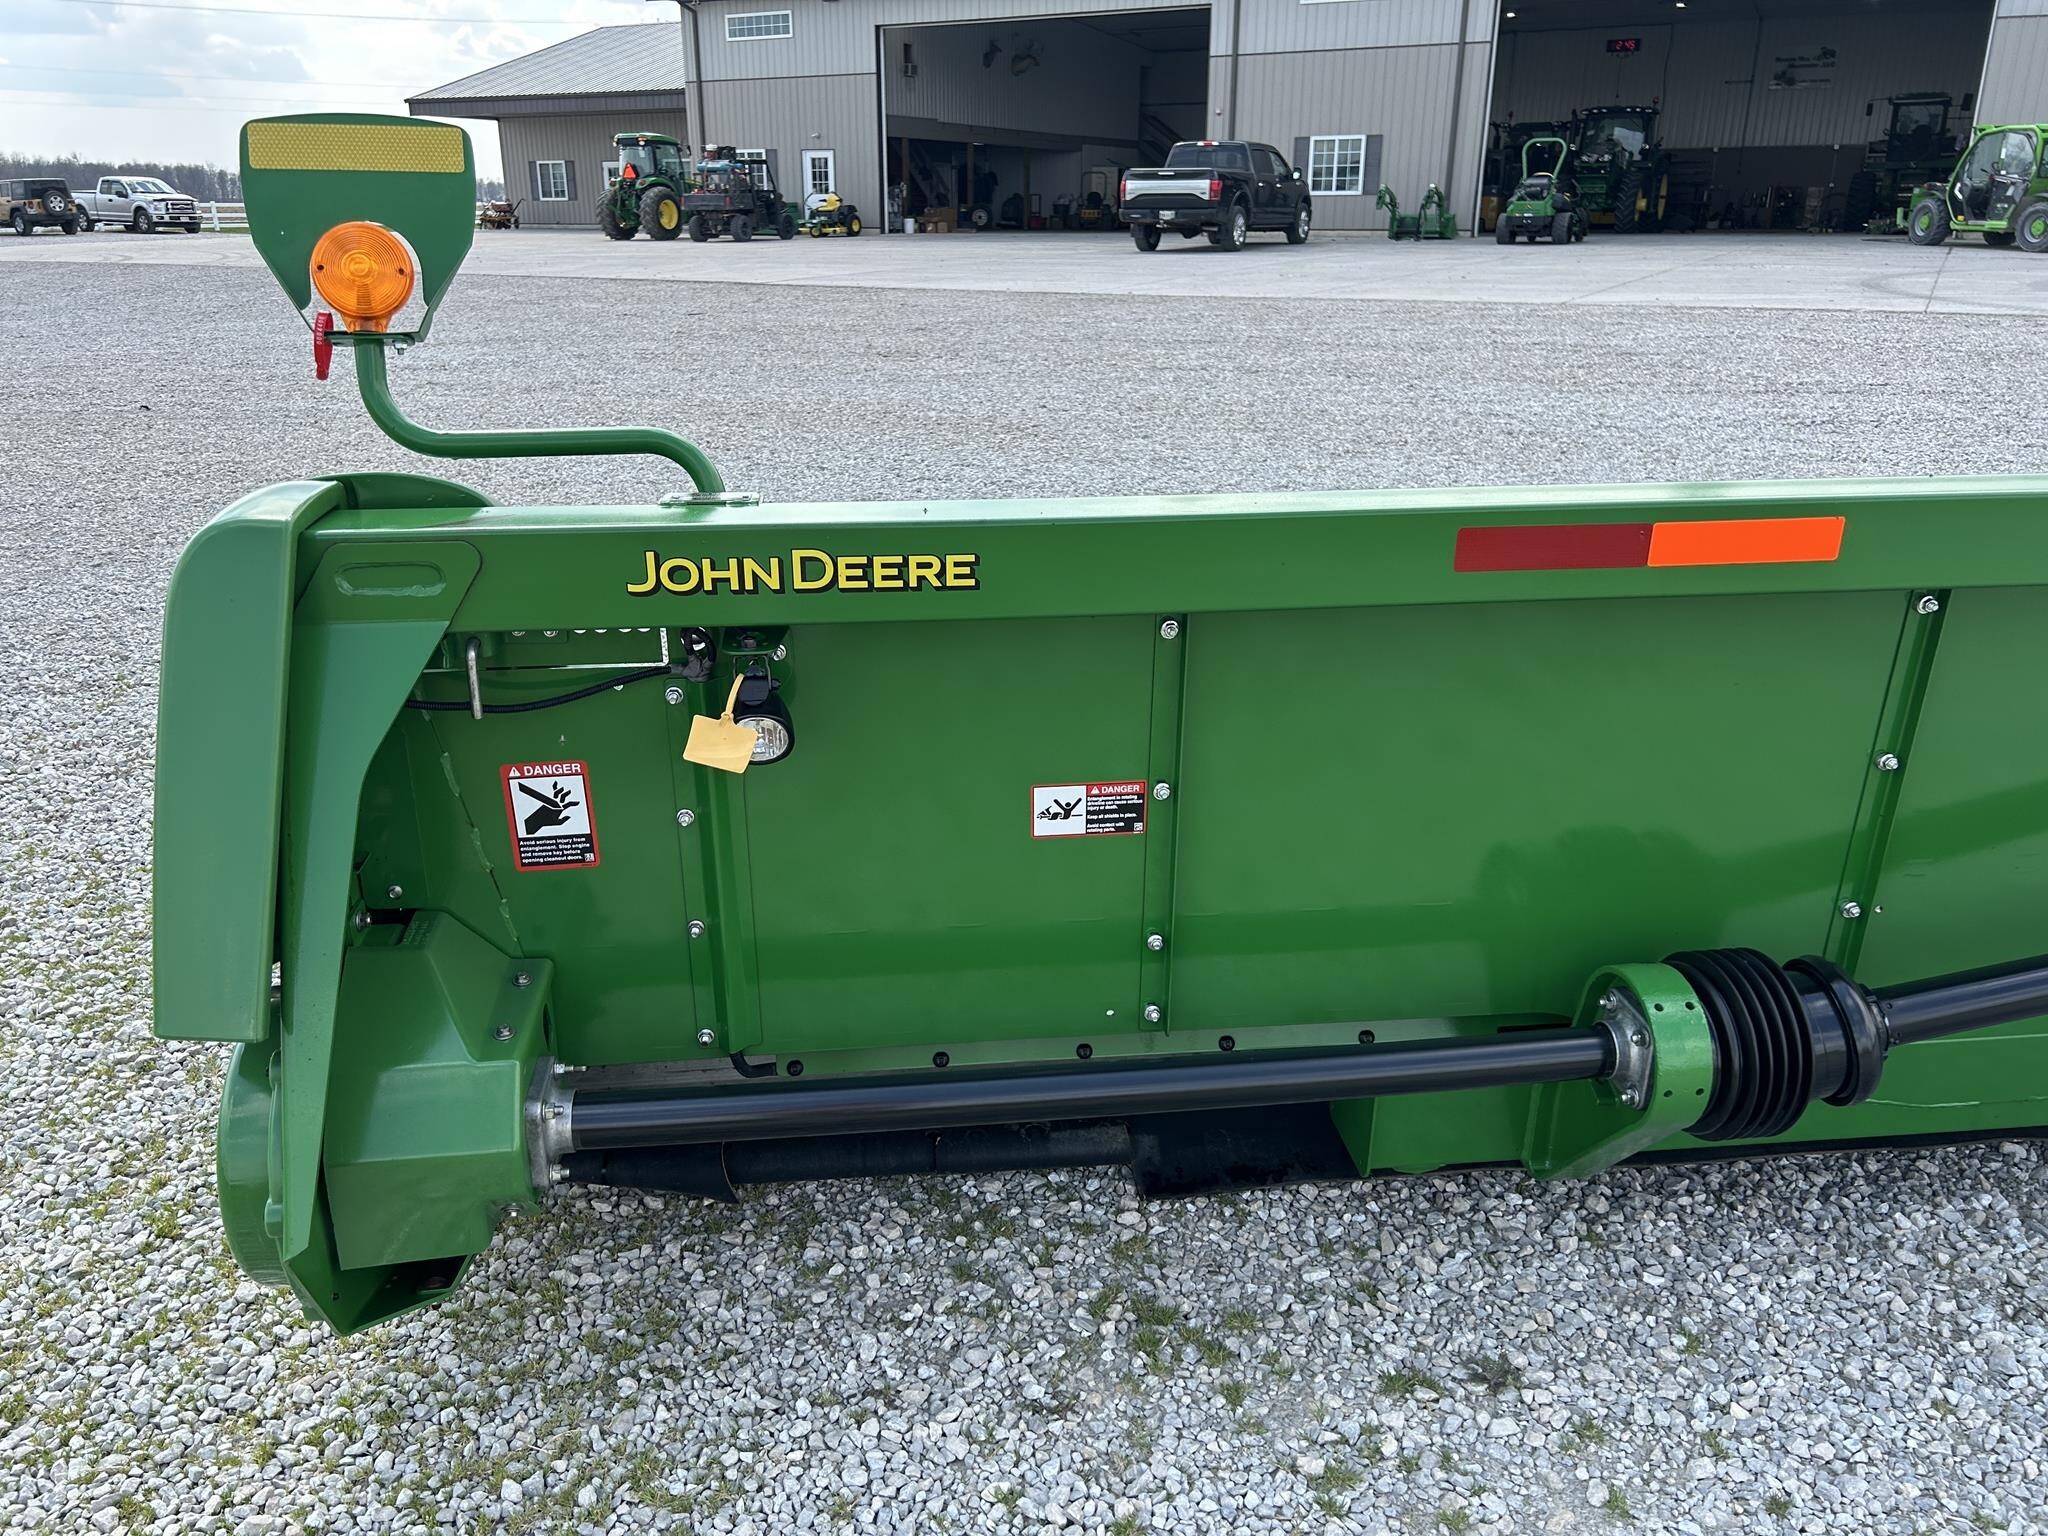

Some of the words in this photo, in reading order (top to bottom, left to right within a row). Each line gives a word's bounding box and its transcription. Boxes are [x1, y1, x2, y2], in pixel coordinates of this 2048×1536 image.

[626, 550, 785, 596] JOHN
[790, 548, 980, 594] DEERE
[524, 764, 581, 776] DANGER
[1102, 785, 1139, 793] DANGER
